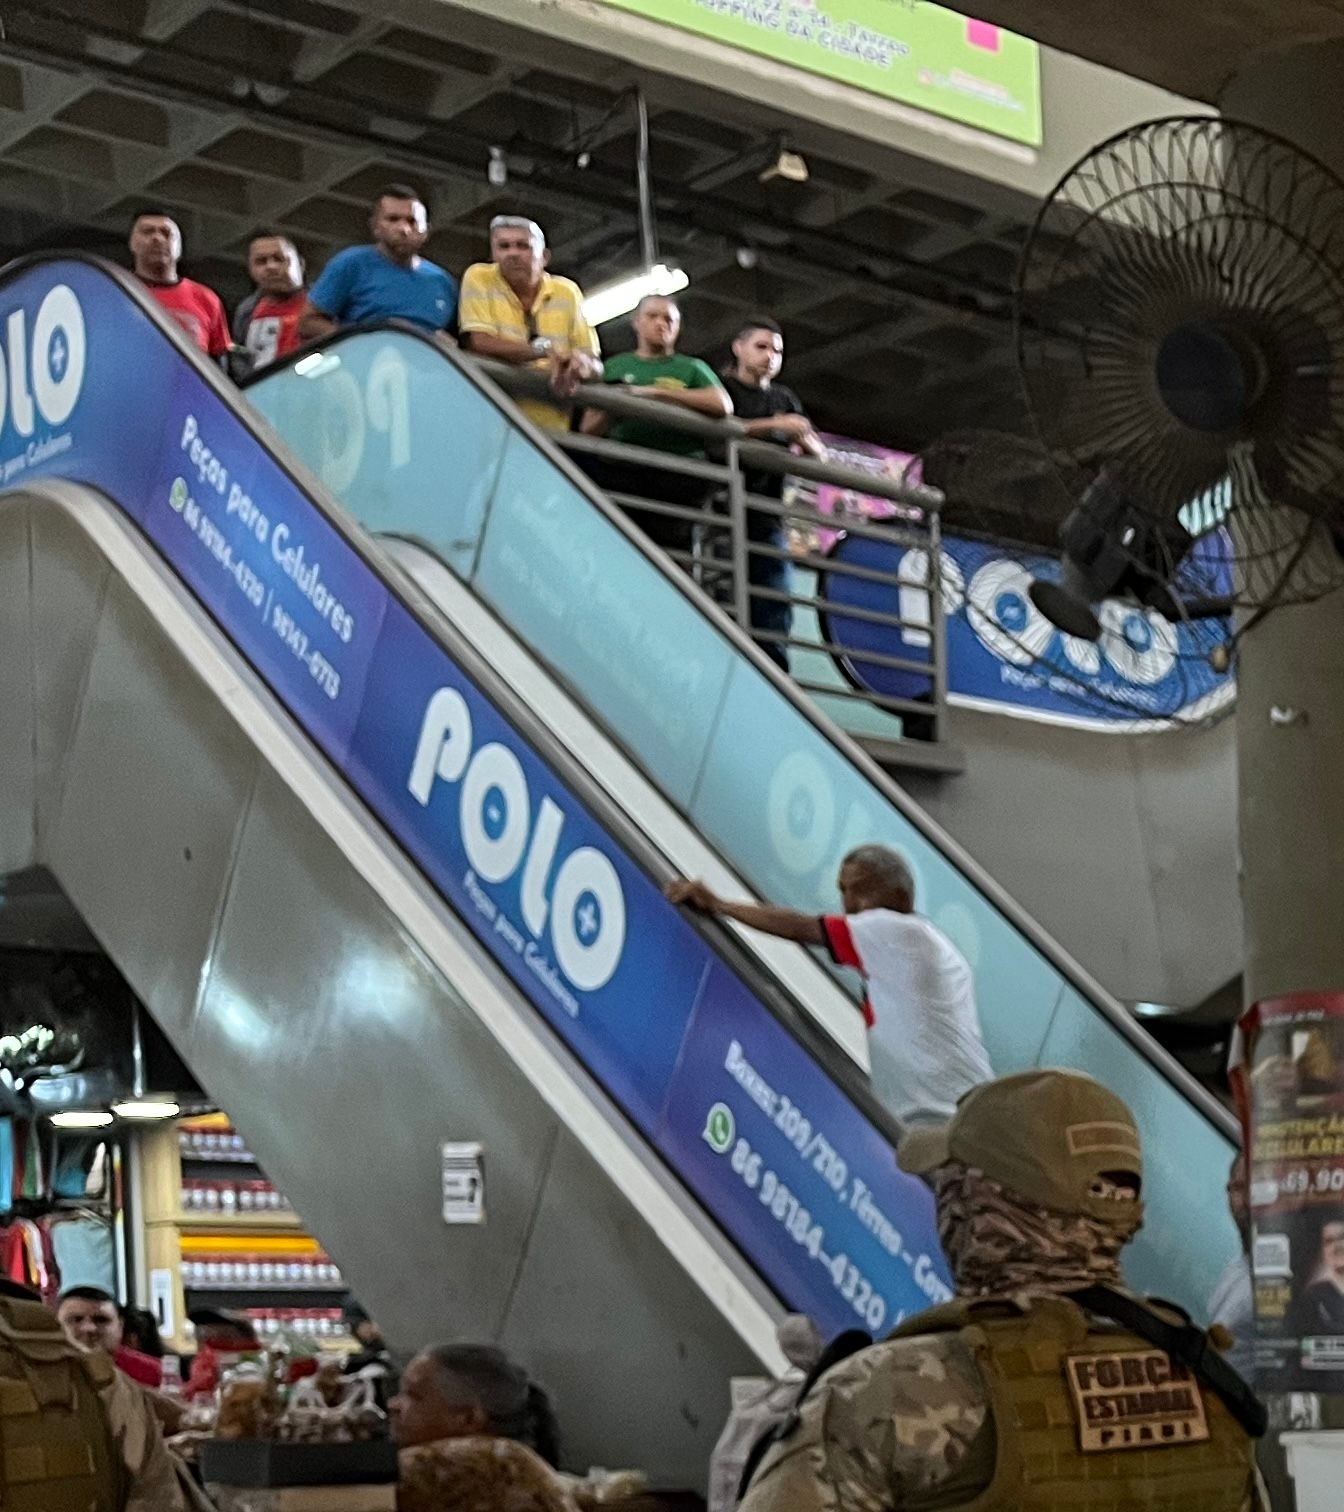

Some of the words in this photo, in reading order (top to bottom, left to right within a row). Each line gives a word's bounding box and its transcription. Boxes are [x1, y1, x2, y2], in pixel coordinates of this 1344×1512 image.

[181, 414, 228, 495] Peças
[226, 482, 269, 543] para
[272, 523, 353, 643] Celulares
[408, 686, 626, 992] POLO
